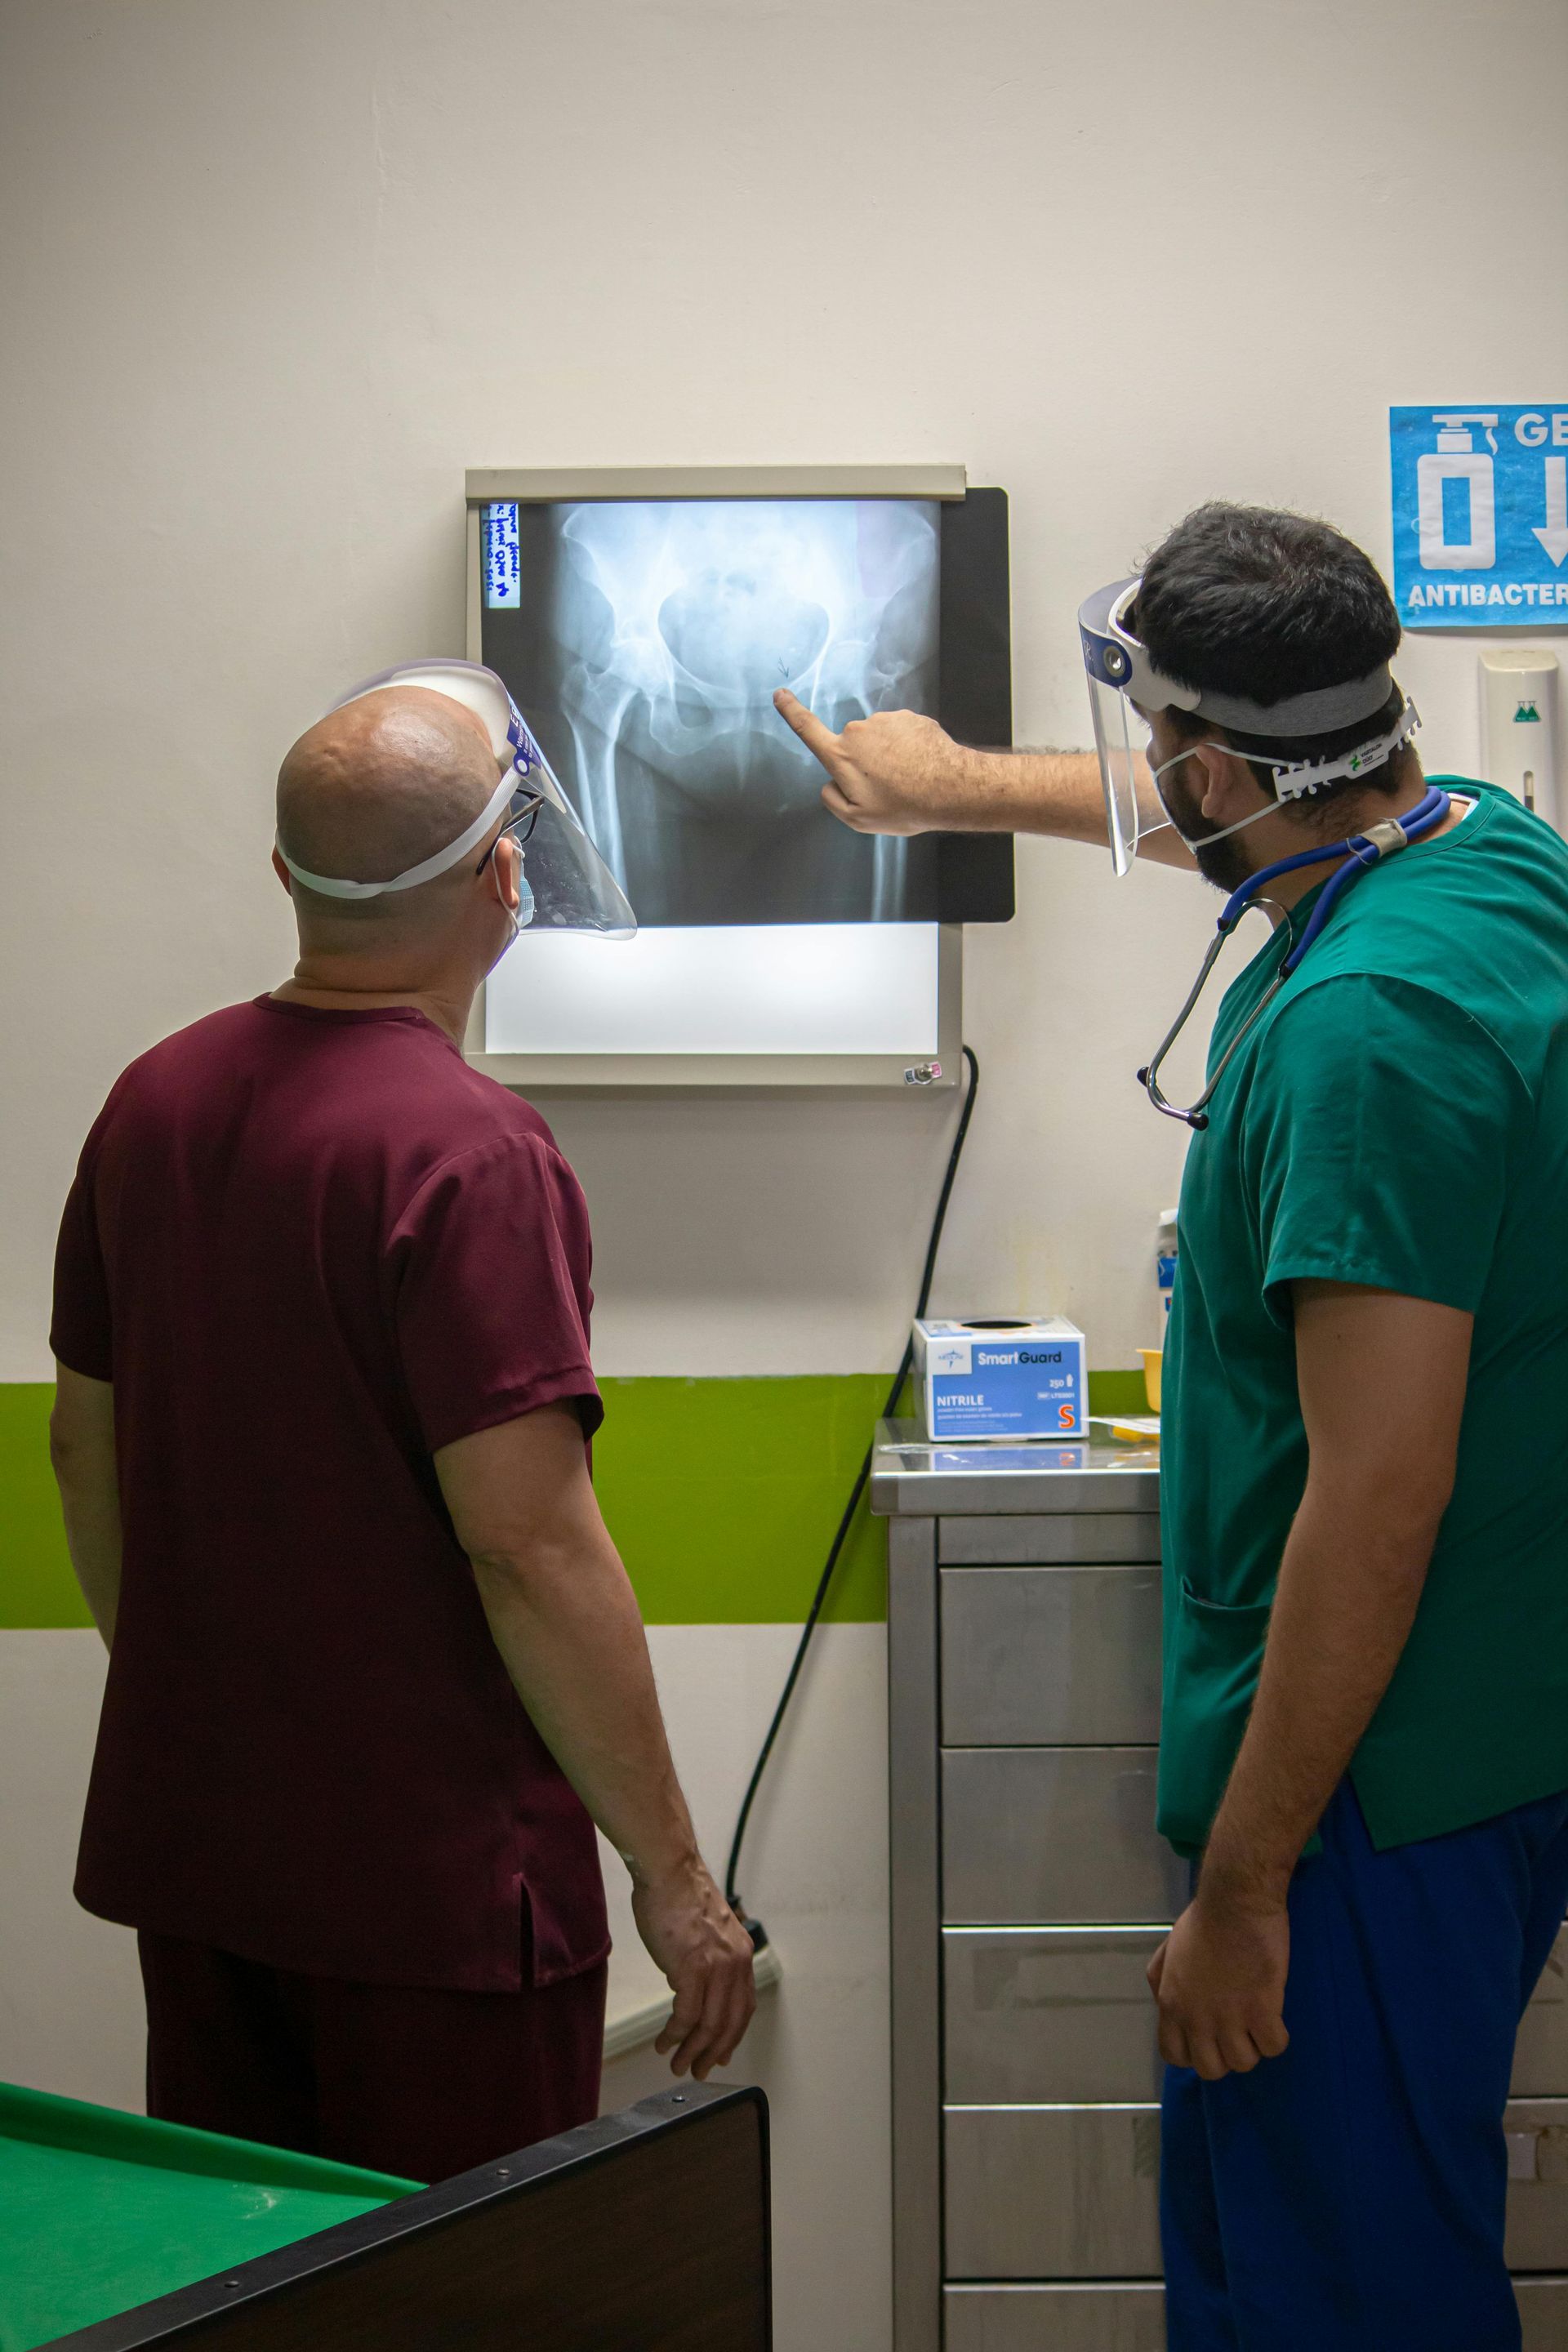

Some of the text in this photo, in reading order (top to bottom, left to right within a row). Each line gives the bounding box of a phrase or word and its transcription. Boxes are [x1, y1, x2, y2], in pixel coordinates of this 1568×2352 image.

[1514, 413, 1568, 447] GE
[1408, 583, 1568, 608] ANTIBACTER
[978, 1352, 1062, 1365] SmartGuard
[937, 1395, 984, 1406] NITRILE
[1058, 1404, 1076, 1428] S
